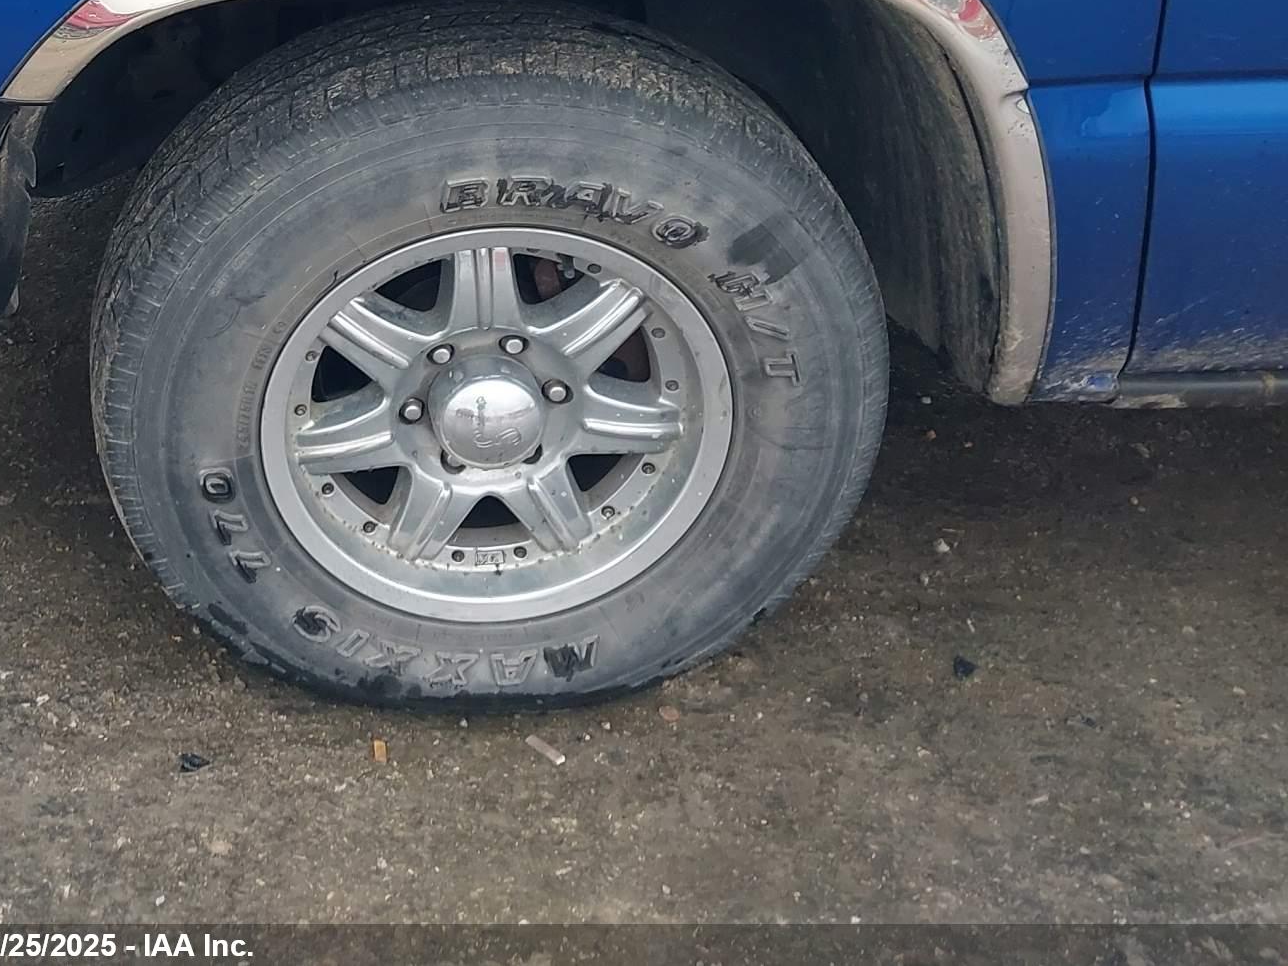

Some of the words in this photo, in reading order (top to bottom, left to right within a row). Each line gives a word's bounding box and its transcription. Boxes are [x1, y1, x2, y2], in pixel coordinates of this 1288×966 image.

[440, 176, 705, 248] BRAVO
[710, 270, 804, 387] H/T
[291, 605, 600, 687] MAXXIS
